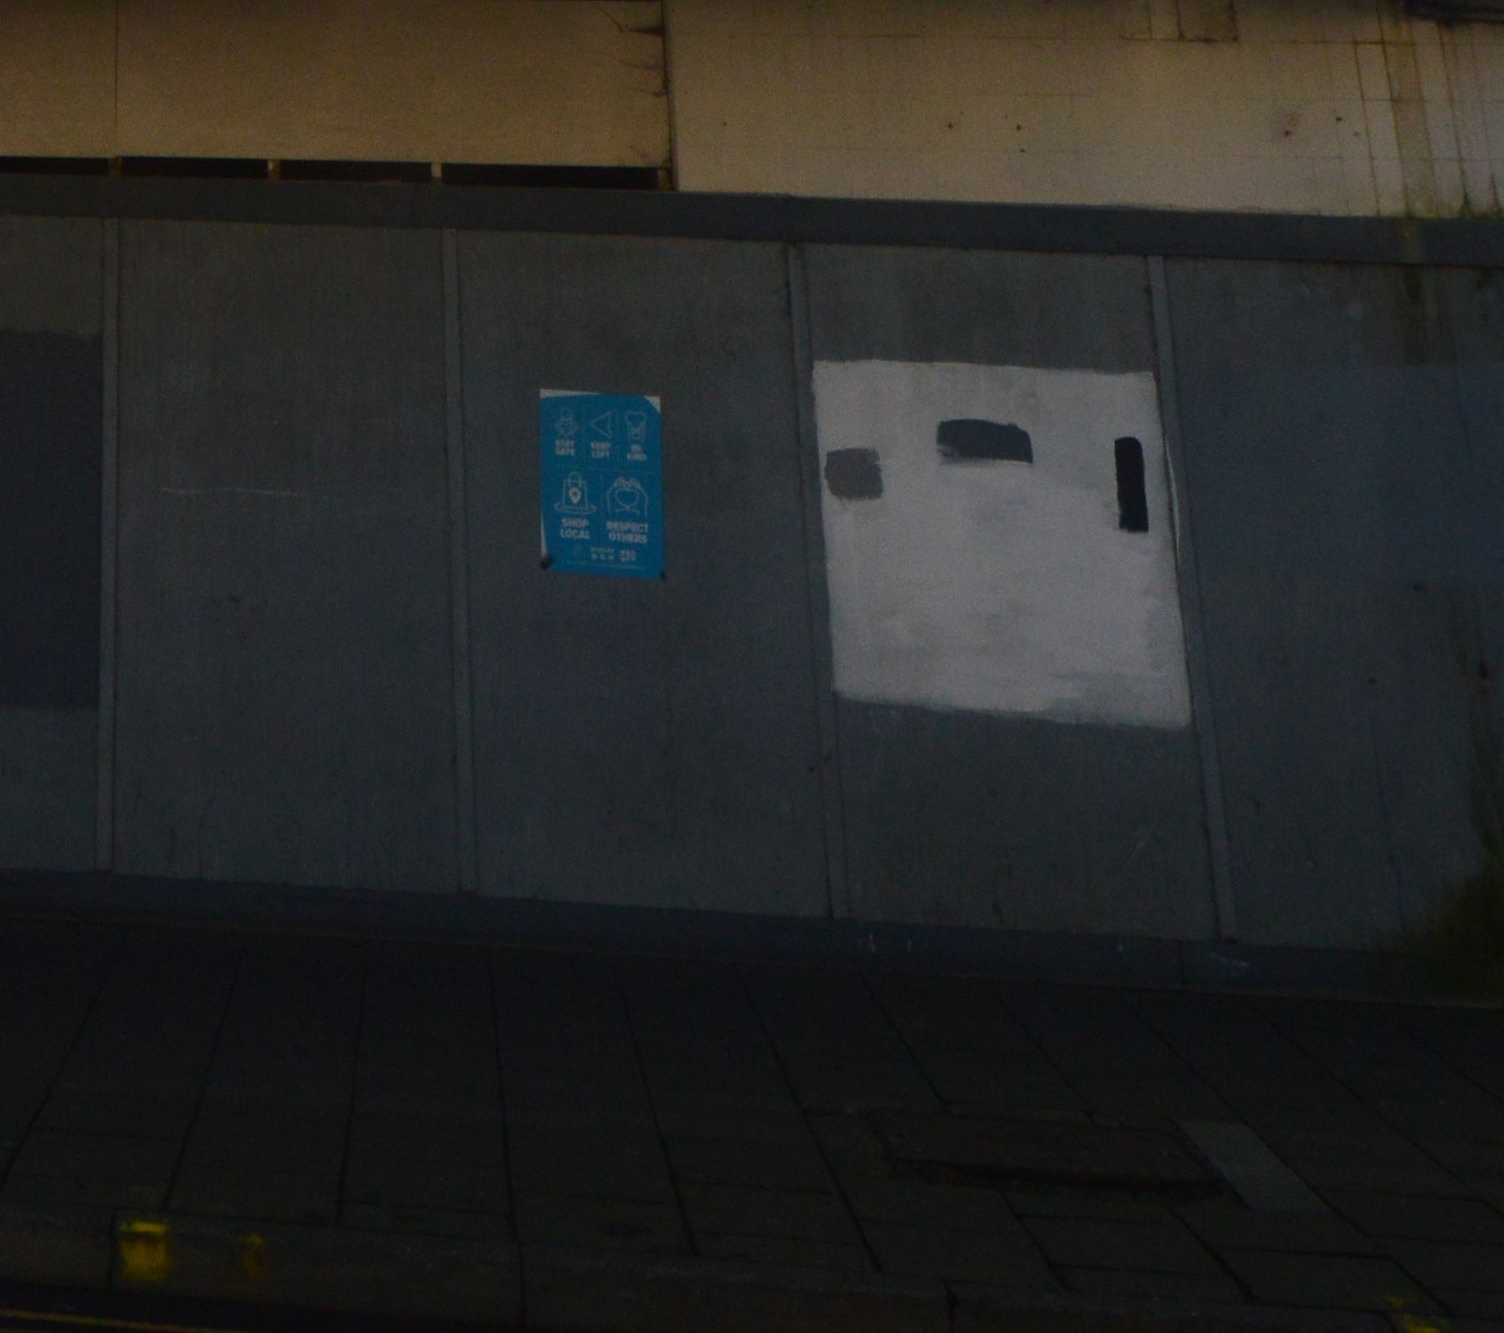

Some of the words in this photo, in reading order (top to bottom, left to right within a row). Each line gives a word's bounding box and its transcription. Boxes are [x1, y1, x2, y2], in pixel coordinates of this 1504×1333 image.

[606, 520, 649, 533] RESPECT
[560, 528, 591, 539] LOCAL
[608, 532, 648, 544] OTHERS
